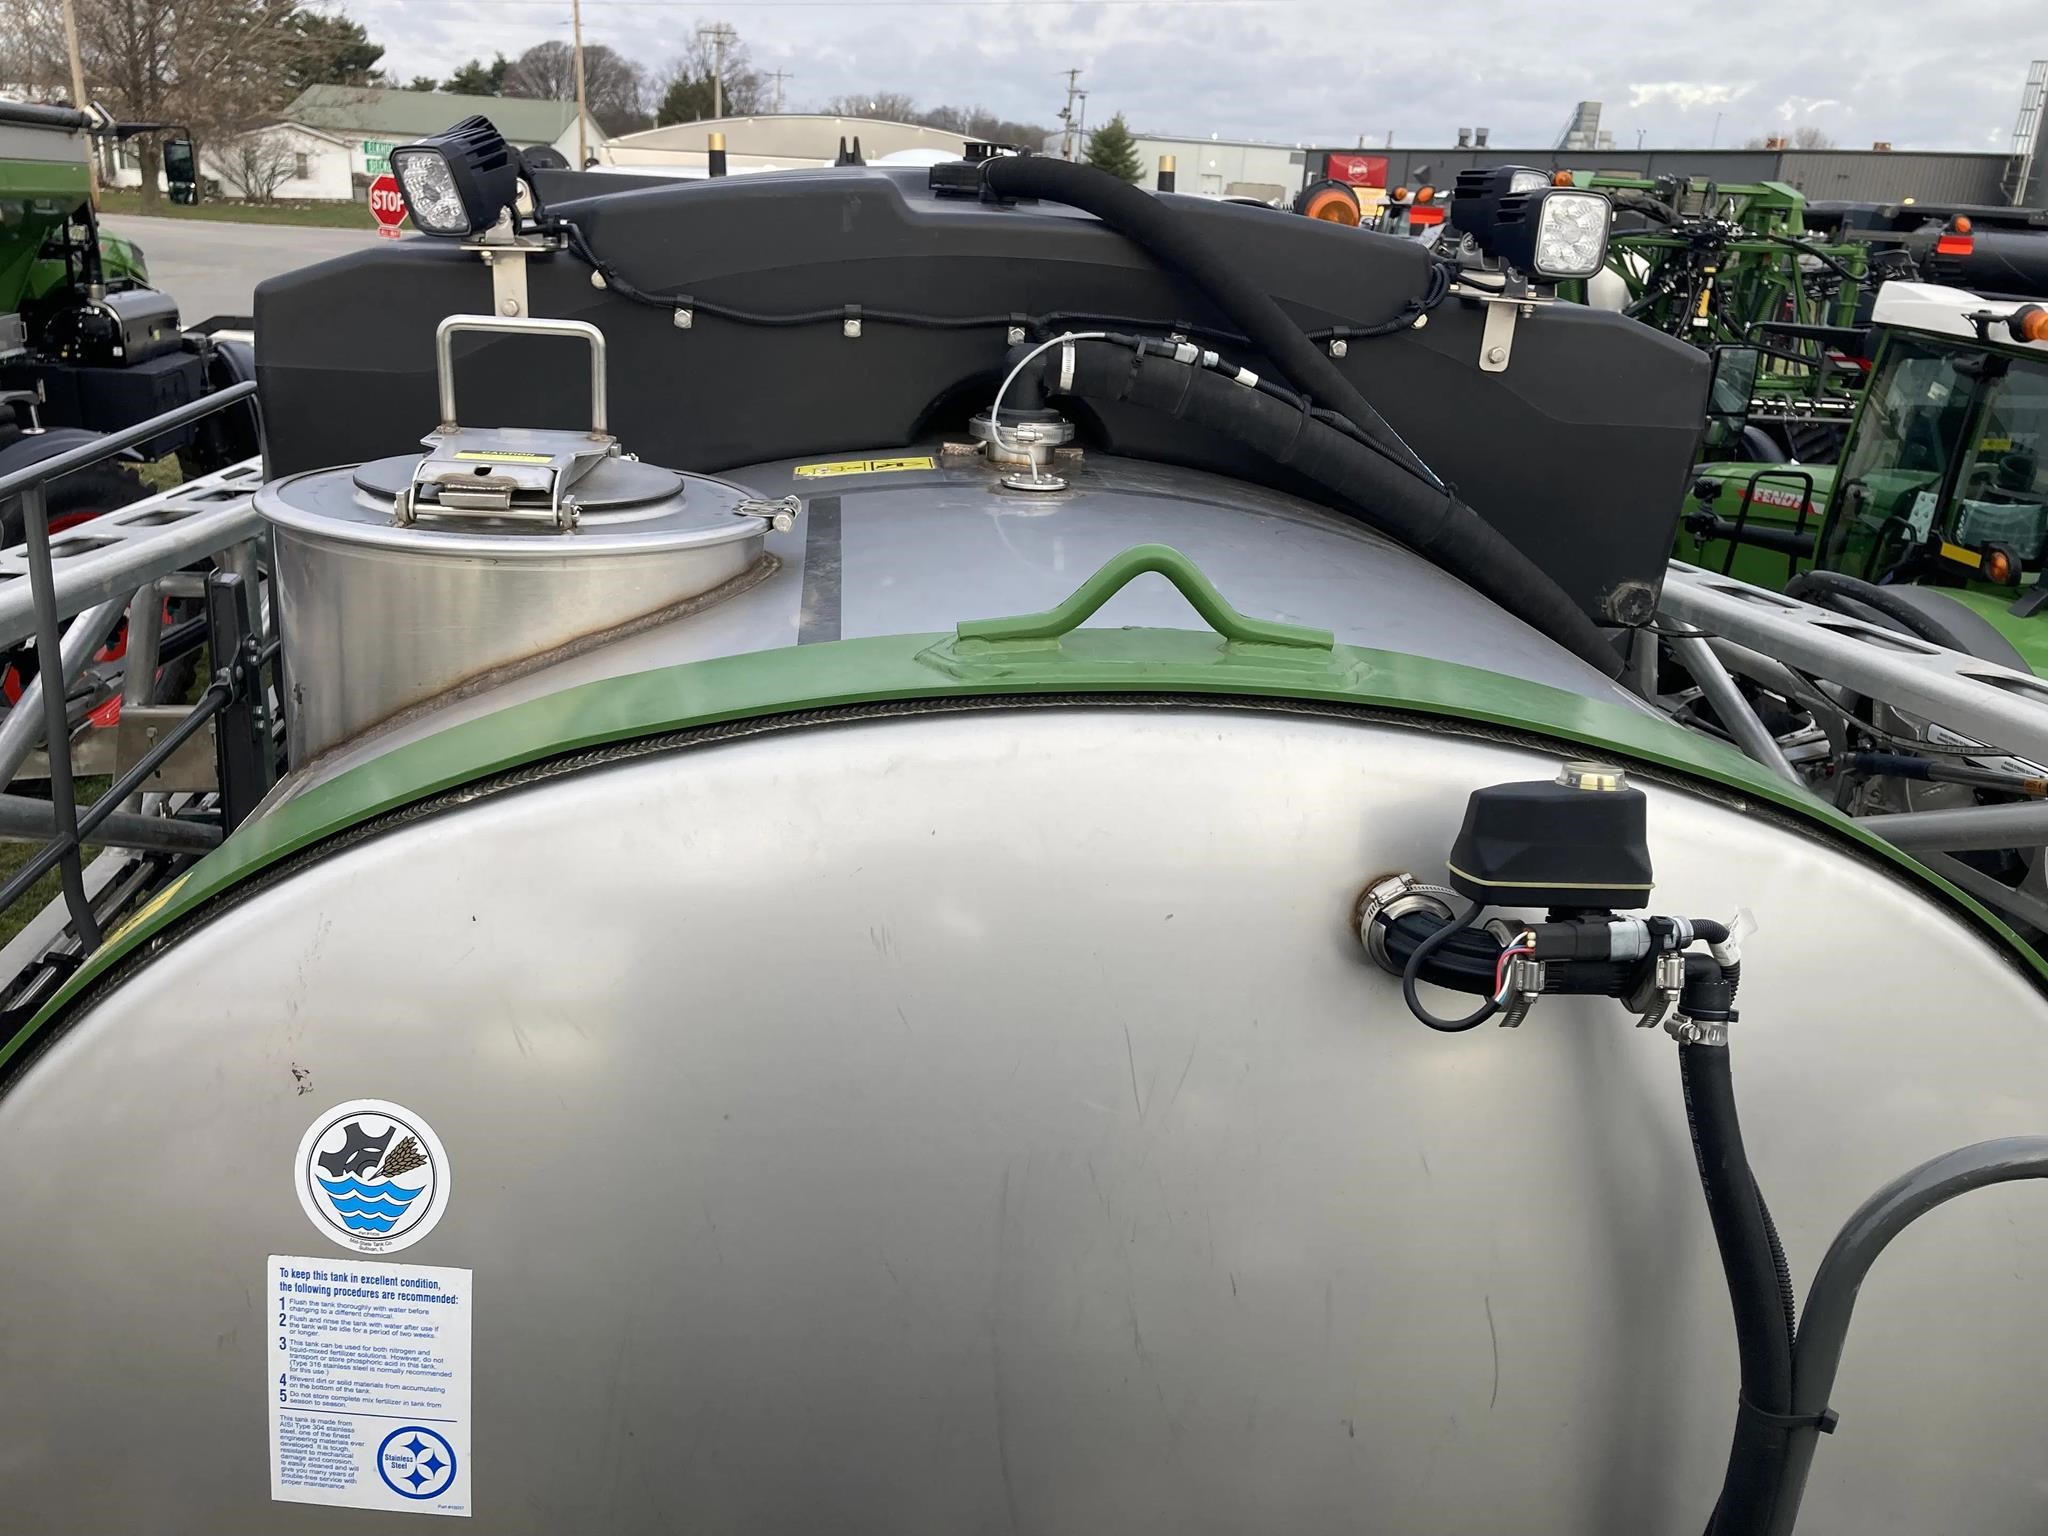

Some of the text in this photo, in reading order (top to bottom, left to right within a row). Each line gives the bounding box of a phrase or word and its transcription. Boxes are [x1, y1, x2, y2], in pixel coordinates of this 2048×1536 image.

[280, 1267, 441, 1290] To keep this tank in excellent condition,
[280, 1282, 458, 1304] the following procedures are recommended:
[279, 1297, 285, 1310] 1
[279, 1313, 286, 1326] 2
[279, 1337, 286, 1350] 3
[280, 1373, 287, 1386] 4
[280, 1389, 287, 1402] 5
[385, 1454, 413, 1462] Stainless
